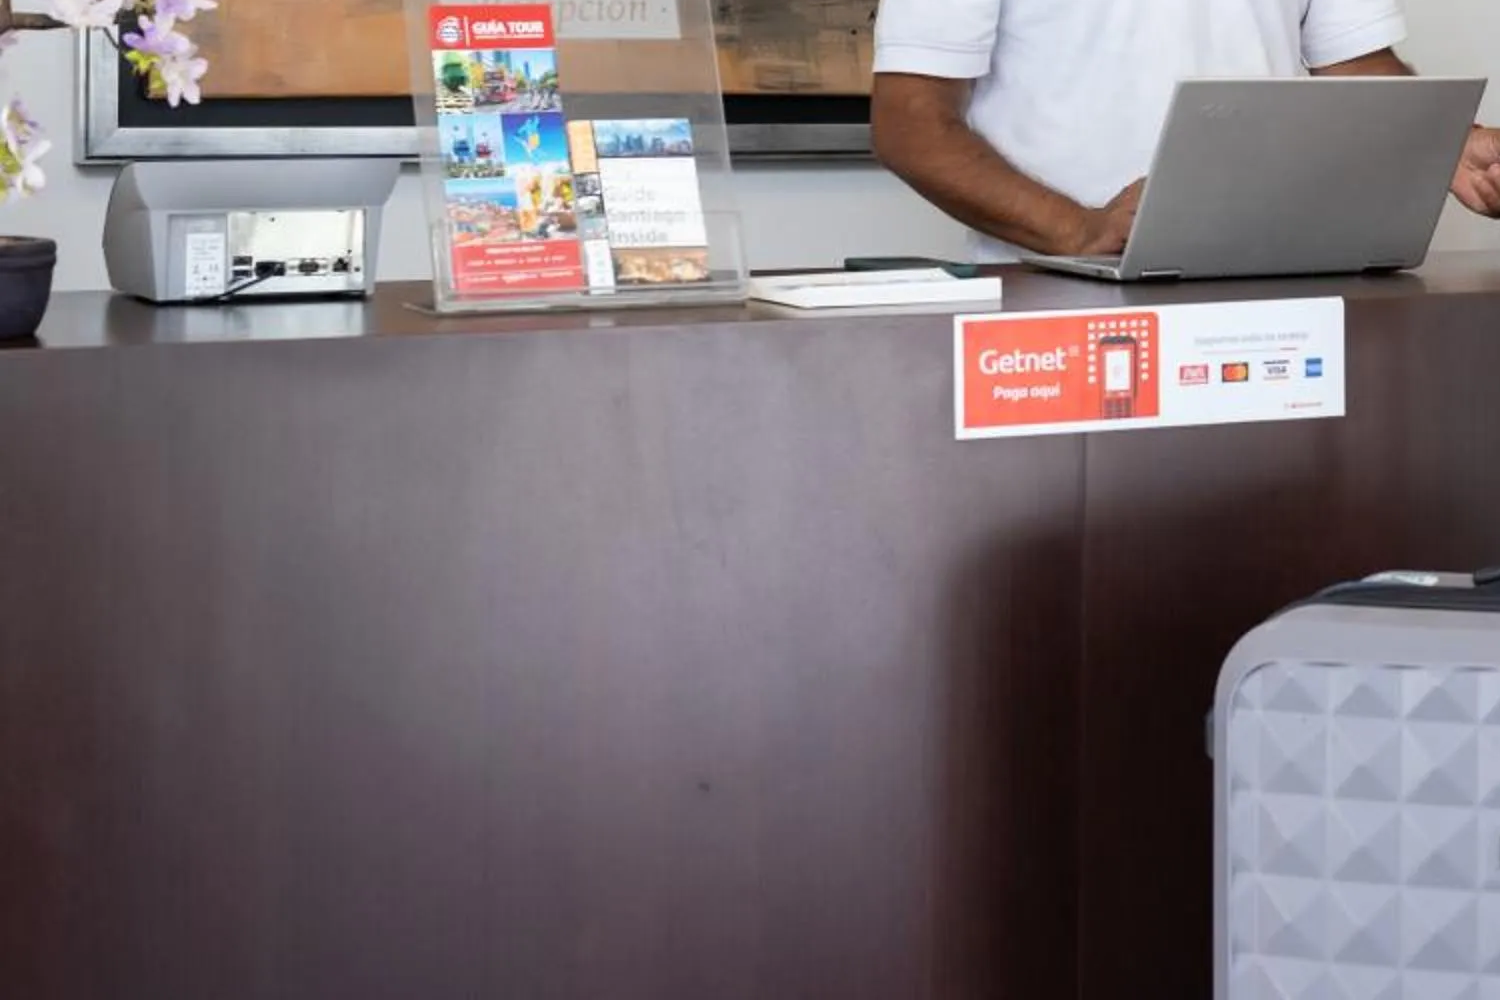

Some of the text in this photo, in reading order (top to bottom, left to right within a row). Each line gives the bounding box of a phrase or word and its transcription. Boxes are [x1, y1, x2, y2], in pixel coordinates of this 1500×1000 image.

[472, 19, 545, 35] GUÍA TOUR
[979, 346, 1067, 375] Getnet
[1029, 381, 1061, 401] aquí
